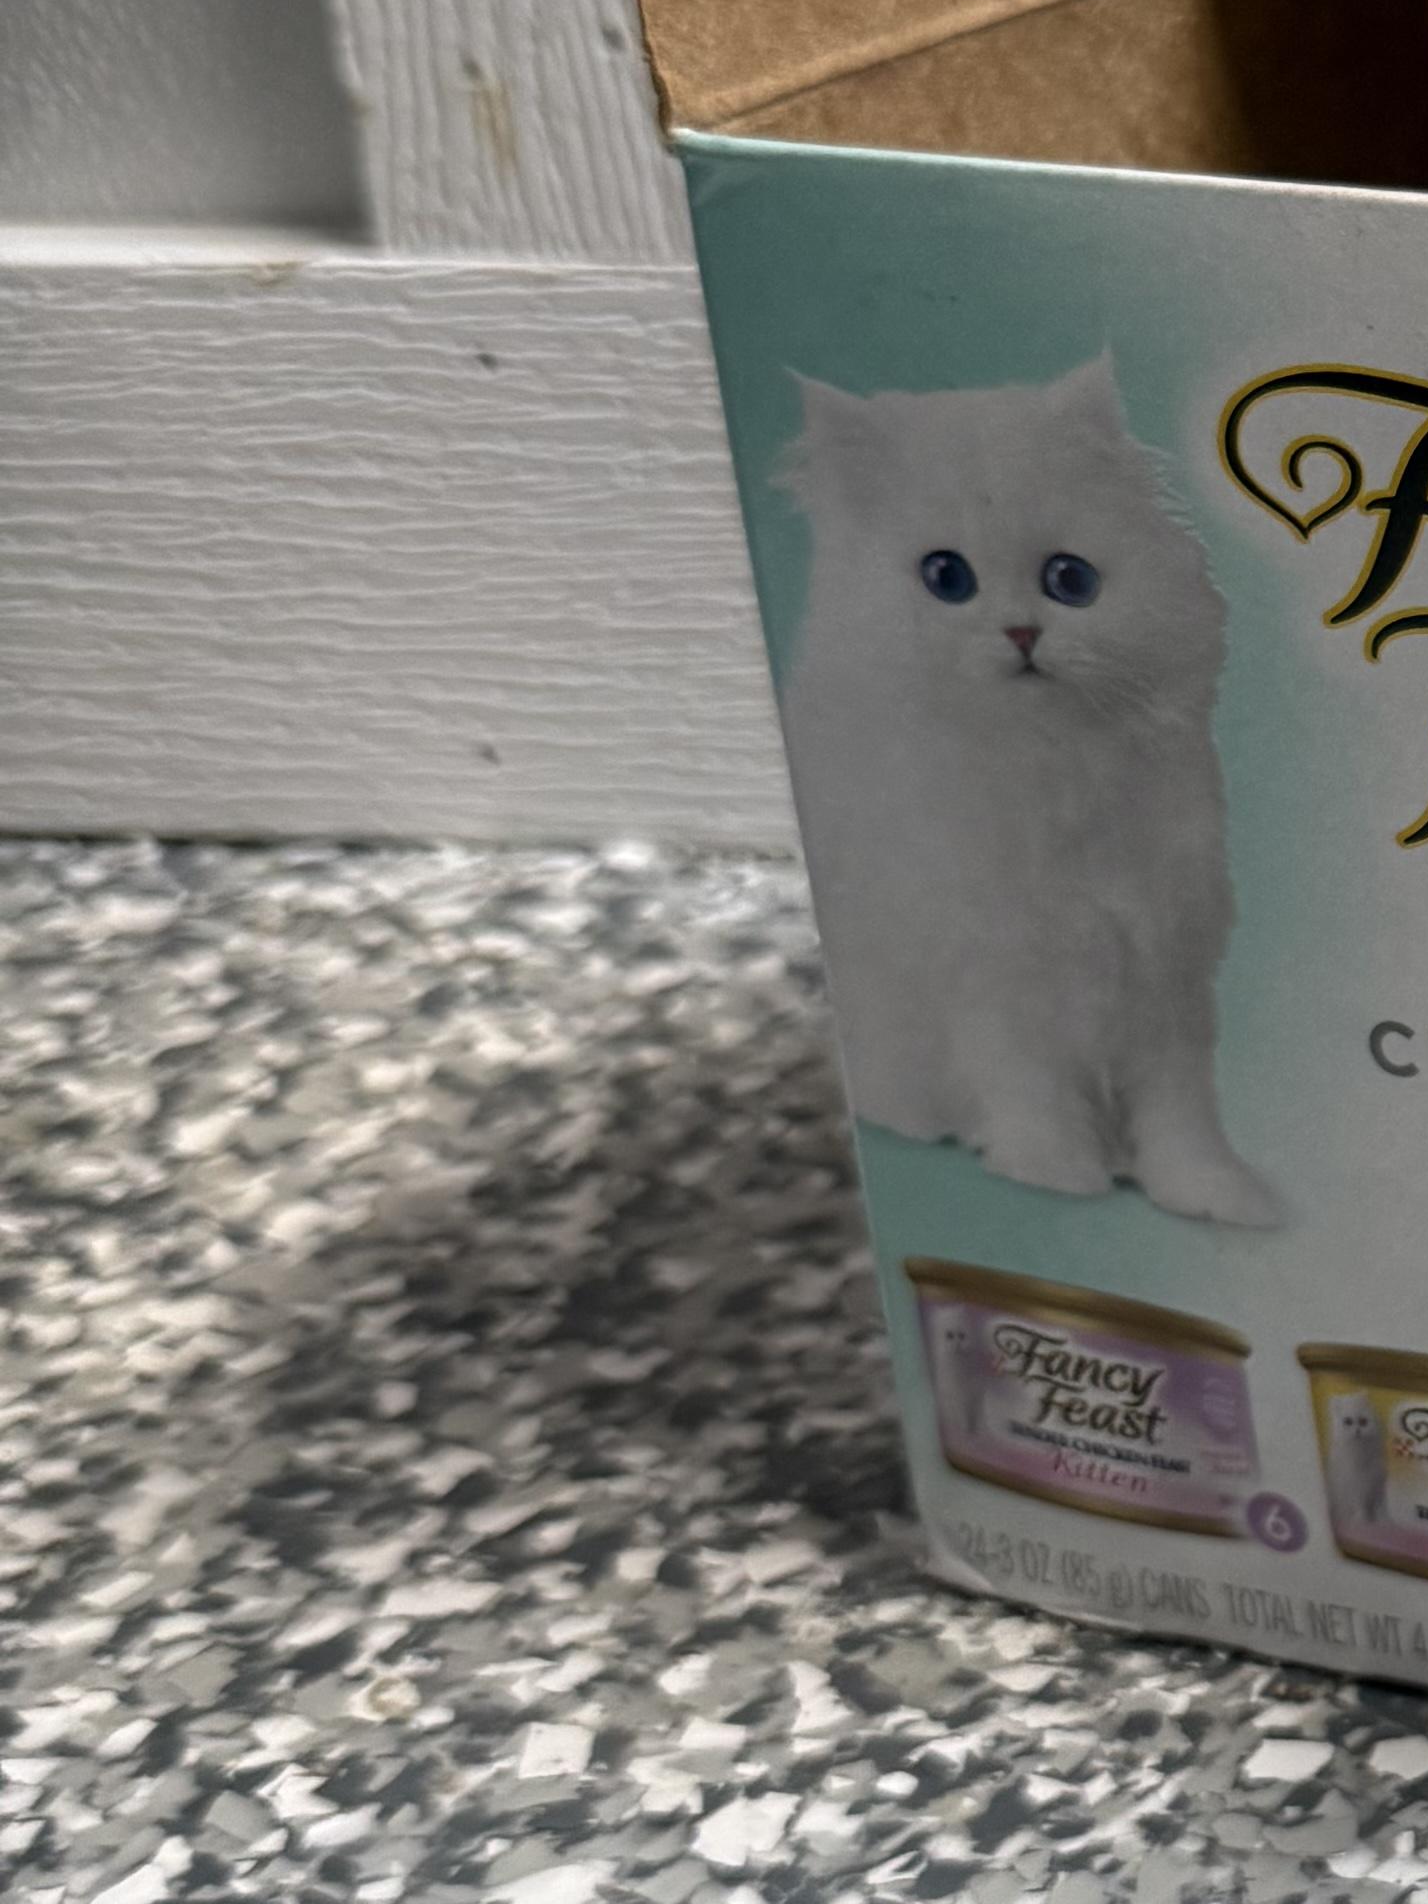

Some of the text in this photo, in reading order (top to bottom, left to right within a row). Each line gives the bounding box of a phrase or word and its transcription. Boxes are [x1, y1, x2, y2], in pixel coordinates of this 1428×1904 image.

[993, 1323, 1166, 1405] Fancy
[1019, 1375, 1167, 1445] Feast
[1052, 1448, 1148, 1493] Kitten
[1264, 1503, 1292, 1542] 6
[1140, 1566, 1213, 1621] CANS
[1221, 1582, 1305, 1640] TOTAL
[1308, 1598, 1359, 1649] NET
[1363, 1610, 1402, 1656] WT
